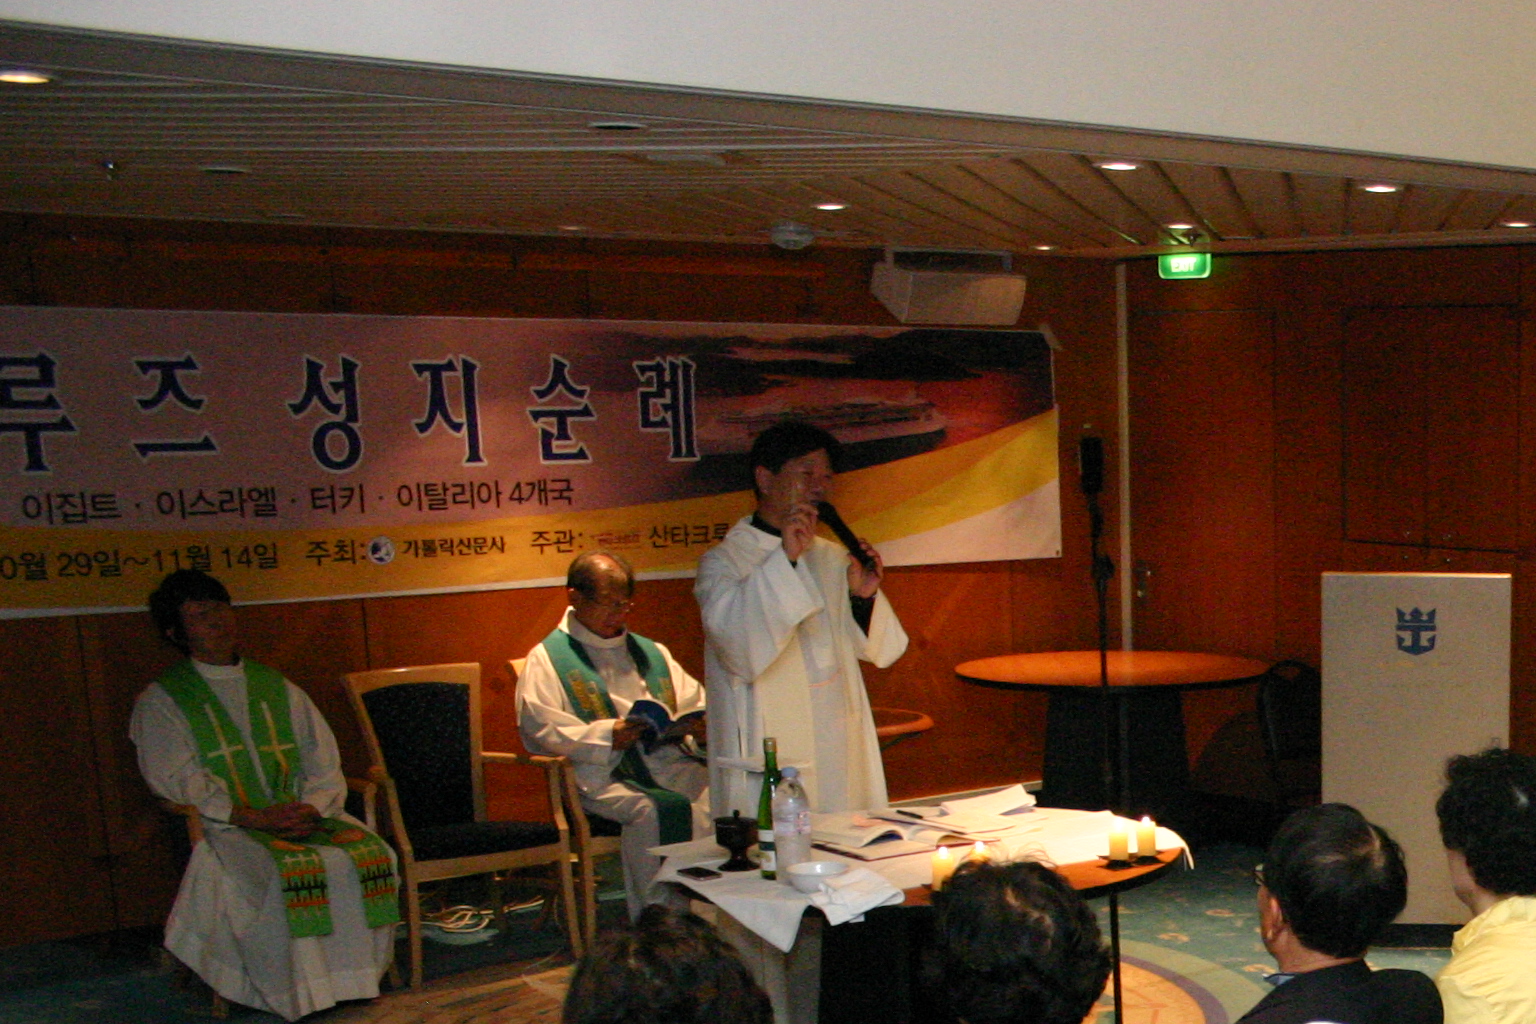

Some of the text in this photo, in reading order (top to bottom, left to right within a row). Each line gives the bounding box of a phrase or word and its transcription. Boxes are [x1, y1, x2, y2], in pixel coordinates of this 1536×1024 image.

[1170, 257, 1197, 272] EXIT
[22, 478, 574, 524] 이집트 이스라엘 터키 이탈리아 4개국
[223, 542, 278, 570] 14일
